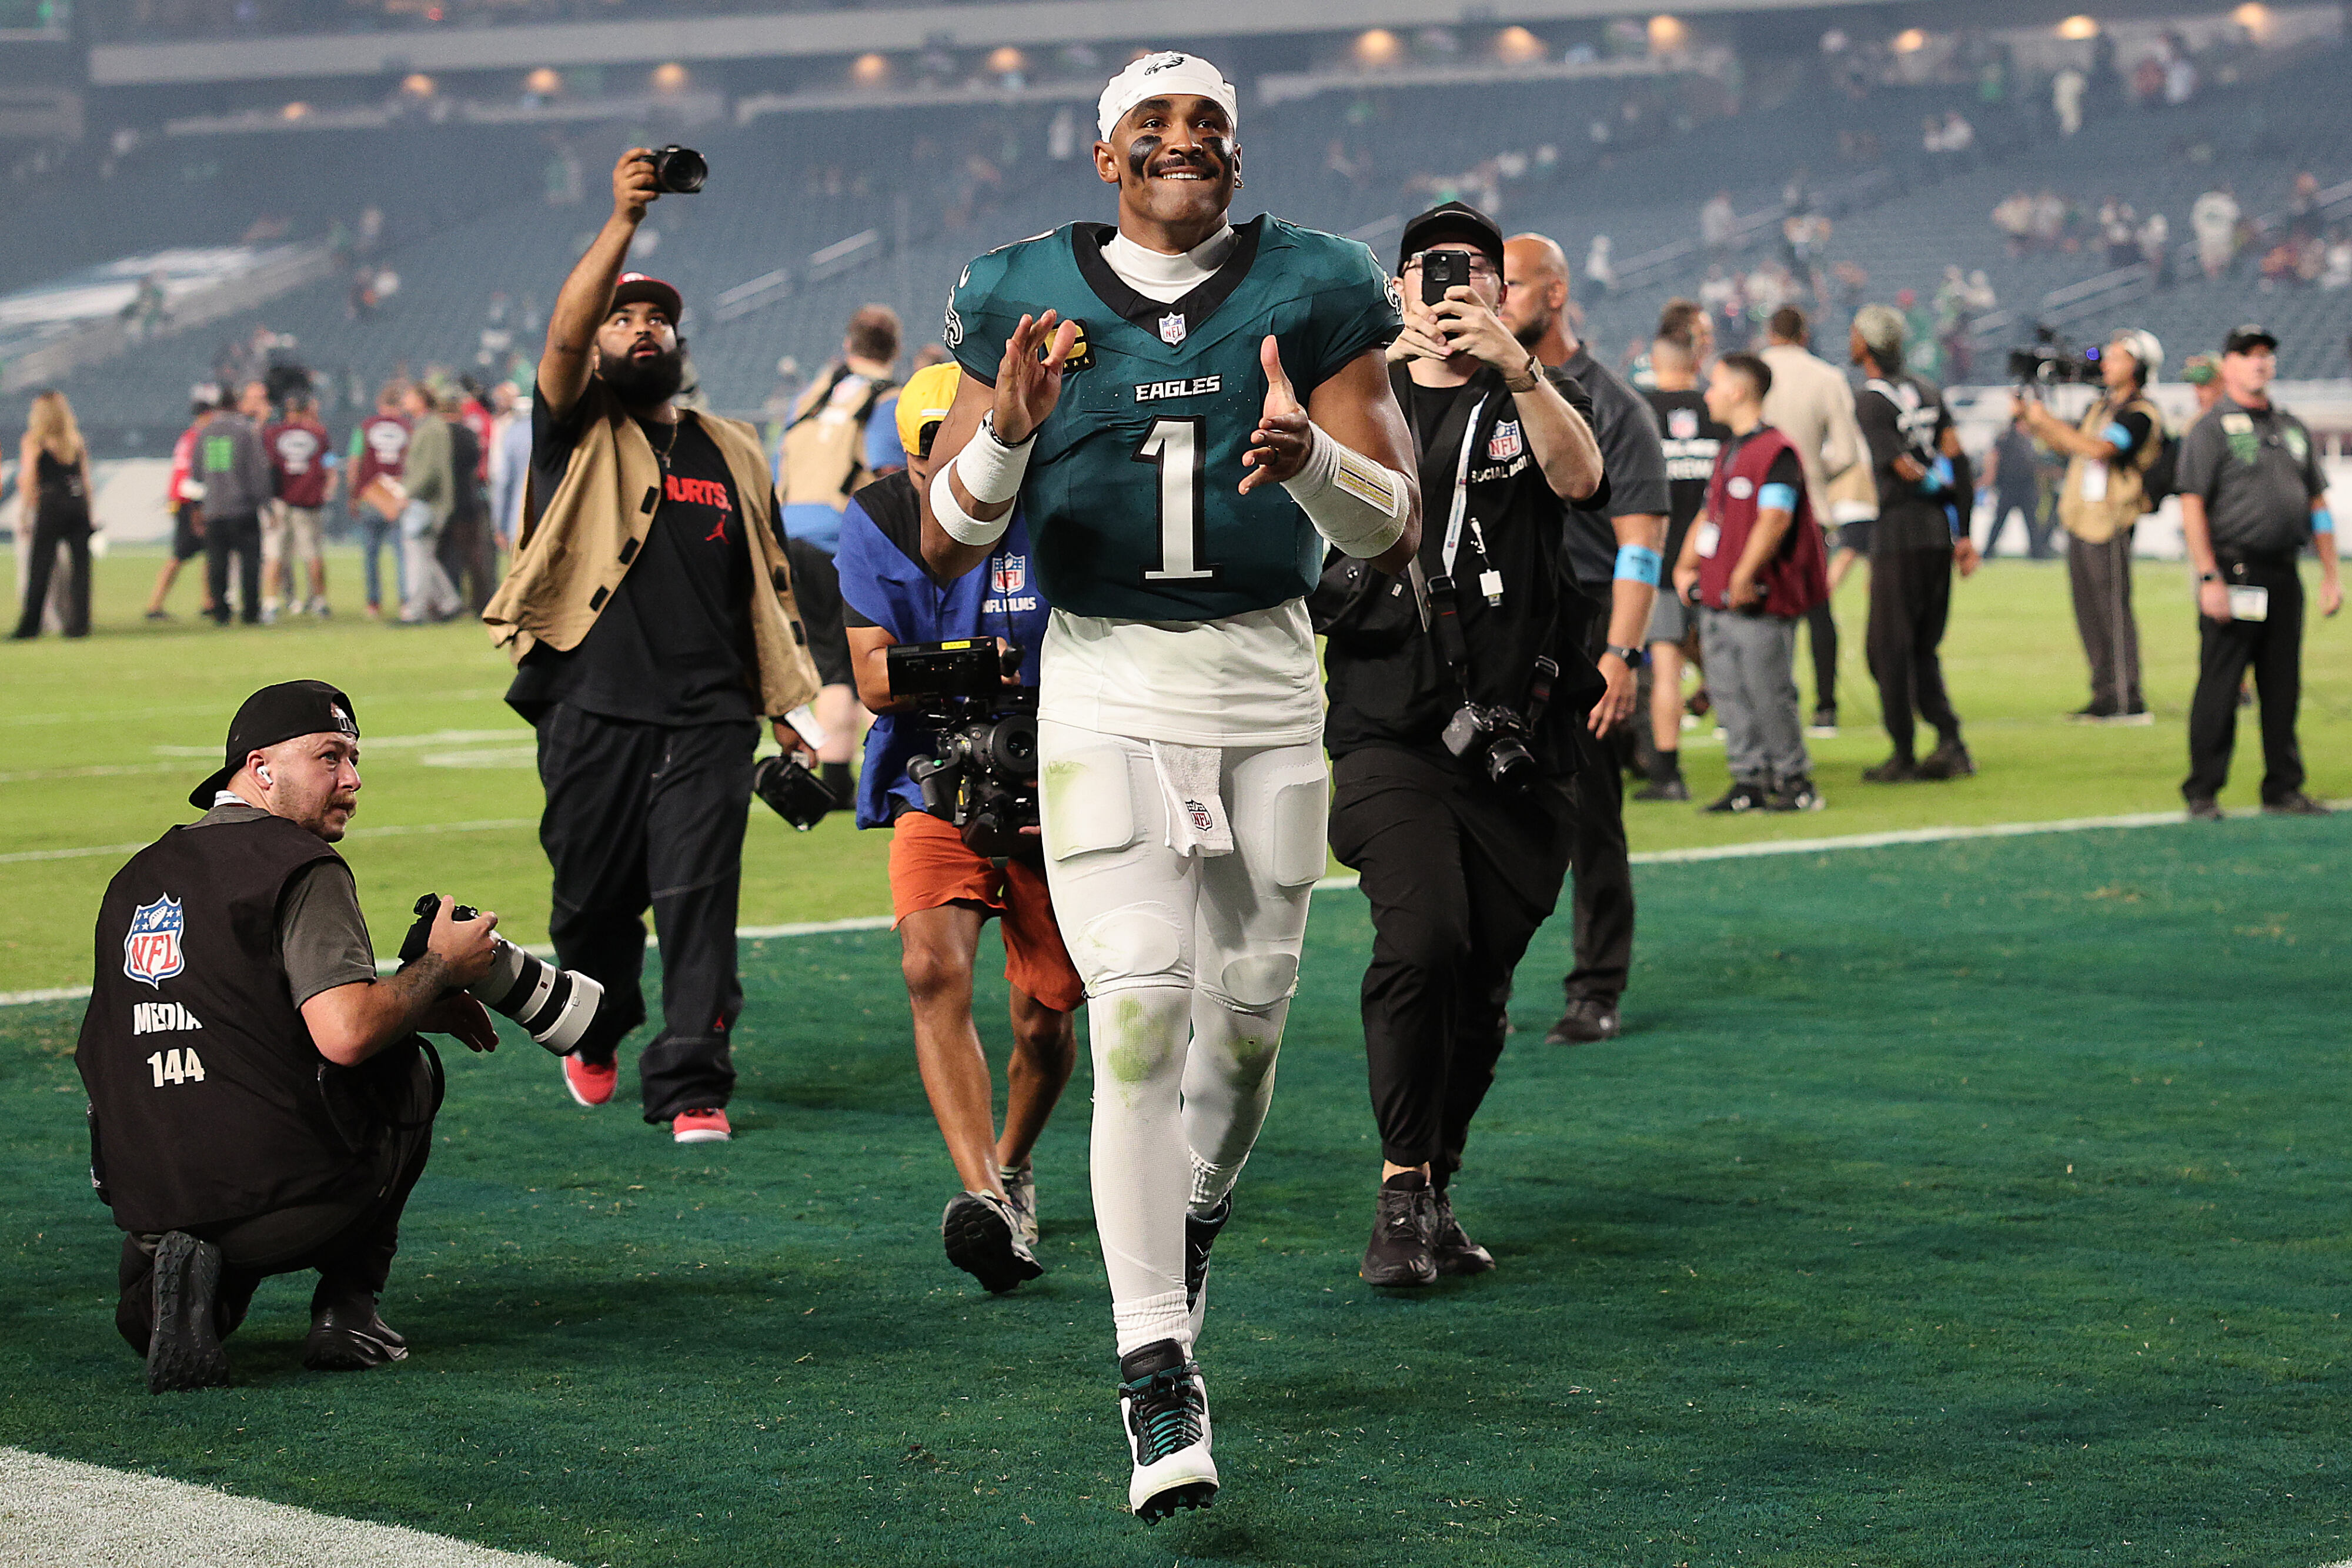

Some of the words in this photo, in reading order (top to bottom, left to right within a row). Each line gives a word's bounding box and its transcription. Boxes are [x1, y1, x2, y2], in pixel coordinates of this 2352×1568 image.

[1165, 326, 1182, 338] NFL
[1135, 375, 1221, 402] EAGLES
[1489, 437, 1518, 455] NFL
[1471, 466, 1509, 483] SOCIAL
[1139, 419, 1214, 580] 1
[996, 571, 1021, 590] NFL
[982, 599, 1003, 613] NFL
[1191, 813, 1210, 827] NFL
[132, 934, 178, 975] NFL
[147, 1047, 205, 1088] 144
